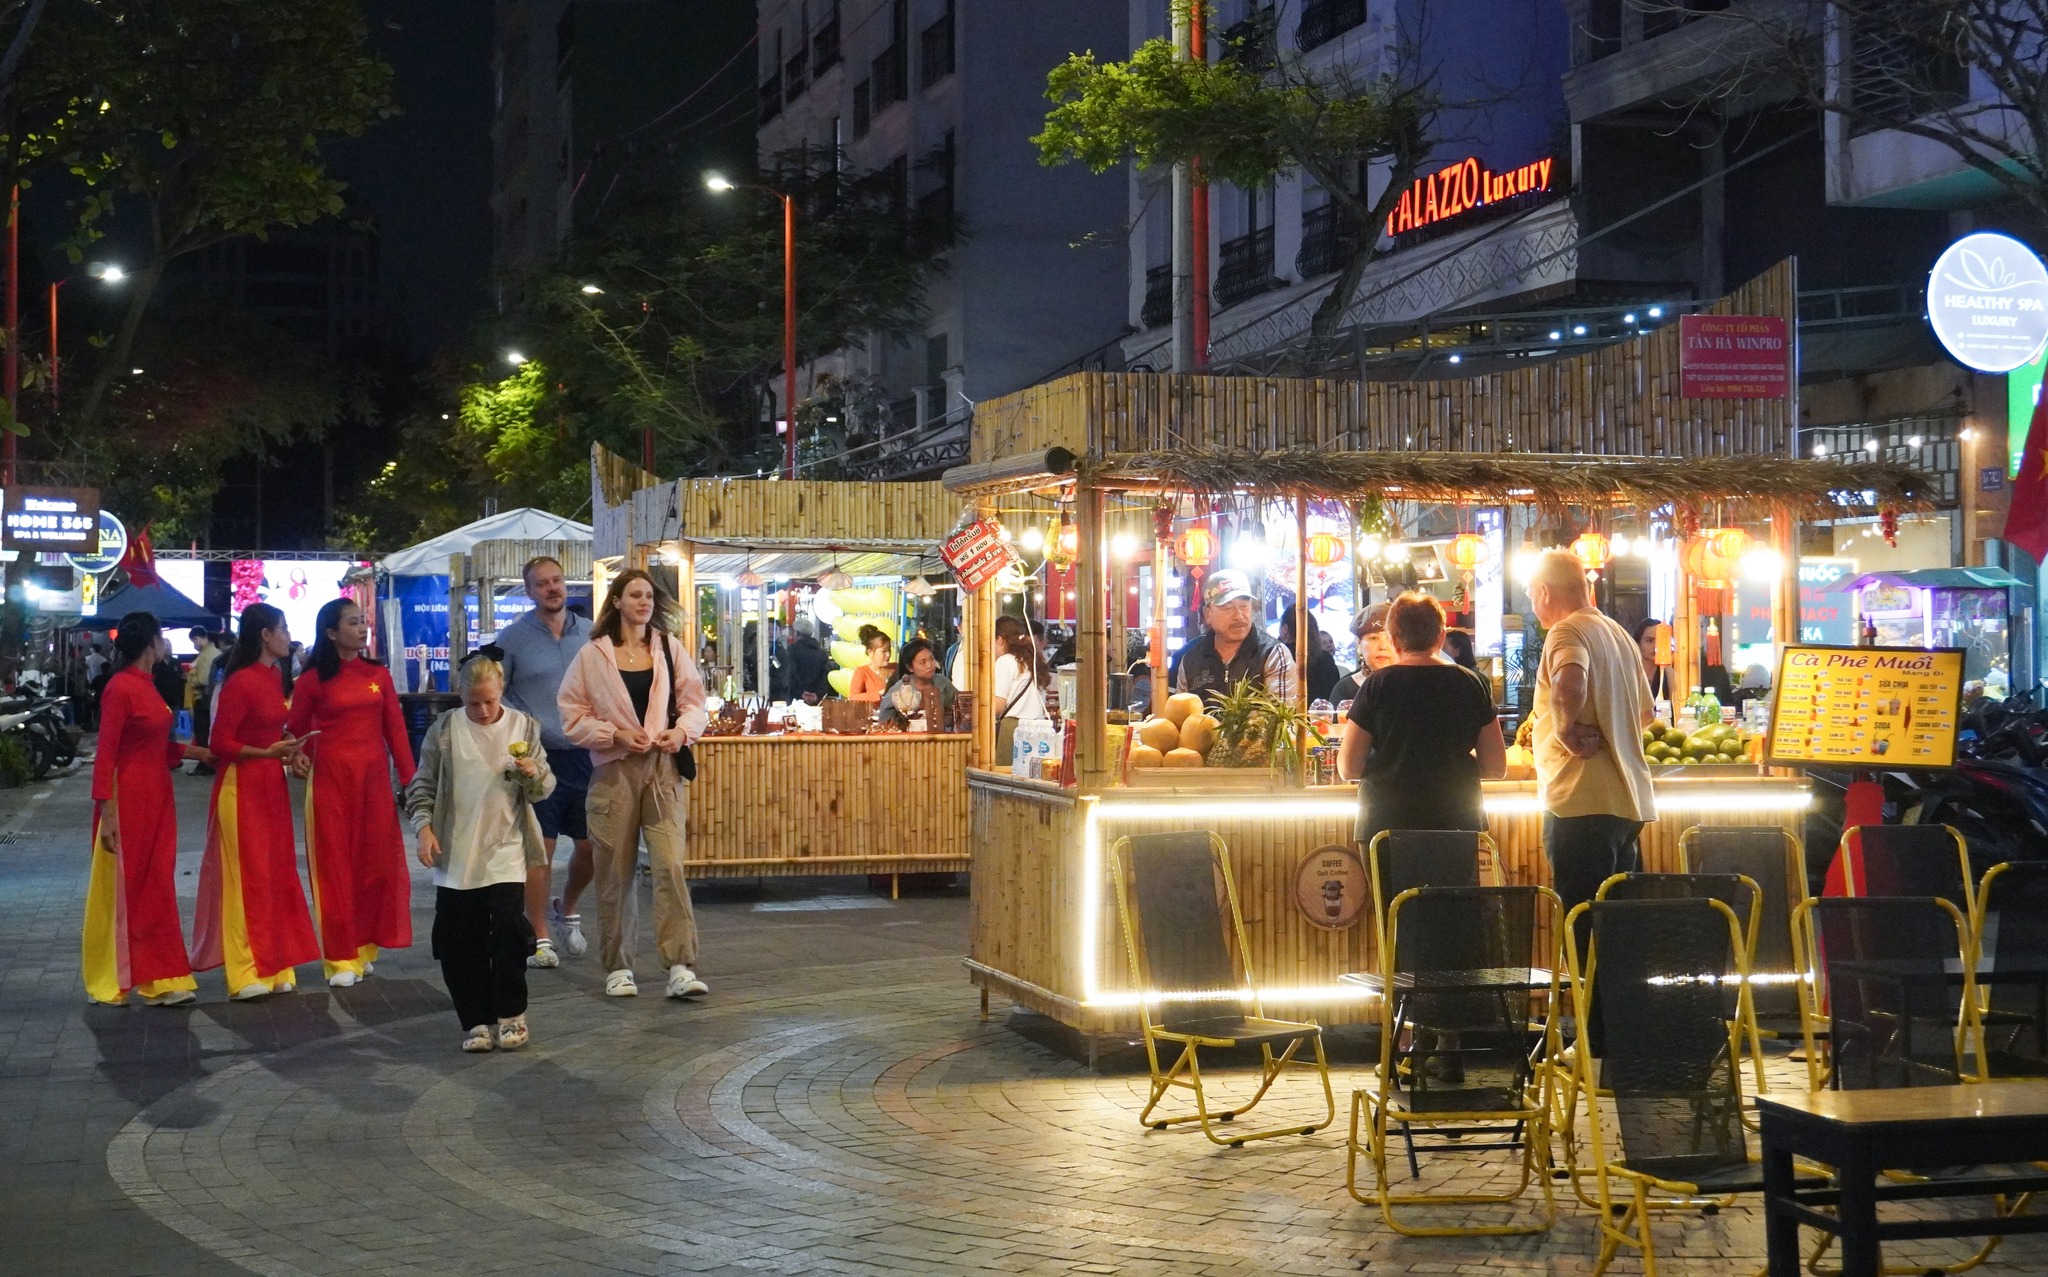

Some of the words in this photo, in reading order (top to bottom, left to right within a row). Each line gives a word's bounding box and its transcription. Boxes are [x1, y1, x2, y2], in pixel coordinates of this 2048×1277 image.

[1483, 157, 1552, 205] Luxury
[1944, 294, 2013, 310] HEALTHY
[2017, 297, 2044, 311] SPA
[1971, 314, 2018, 327] LUXURY
[1737, 337, 1782, 350] WINPRO
[7, 514, 58, 529] HOME
[61, 516, 93, 530] 365
[13, 530, 32, 539] SPA
[414, 603, 430, 613] HỘI
[431, 603, 448, 612] LIÊN
[1750, 606, 1838, 621] PHACY
[1791, 653, 1820, 667] Cà
[1826, 654, 1869, 669] Phê
[1874, 721, 1891, 730] SODA
[1321, 859, 1343, 868] COFFEE
[1329, 869, 1349, 877] Coffee
